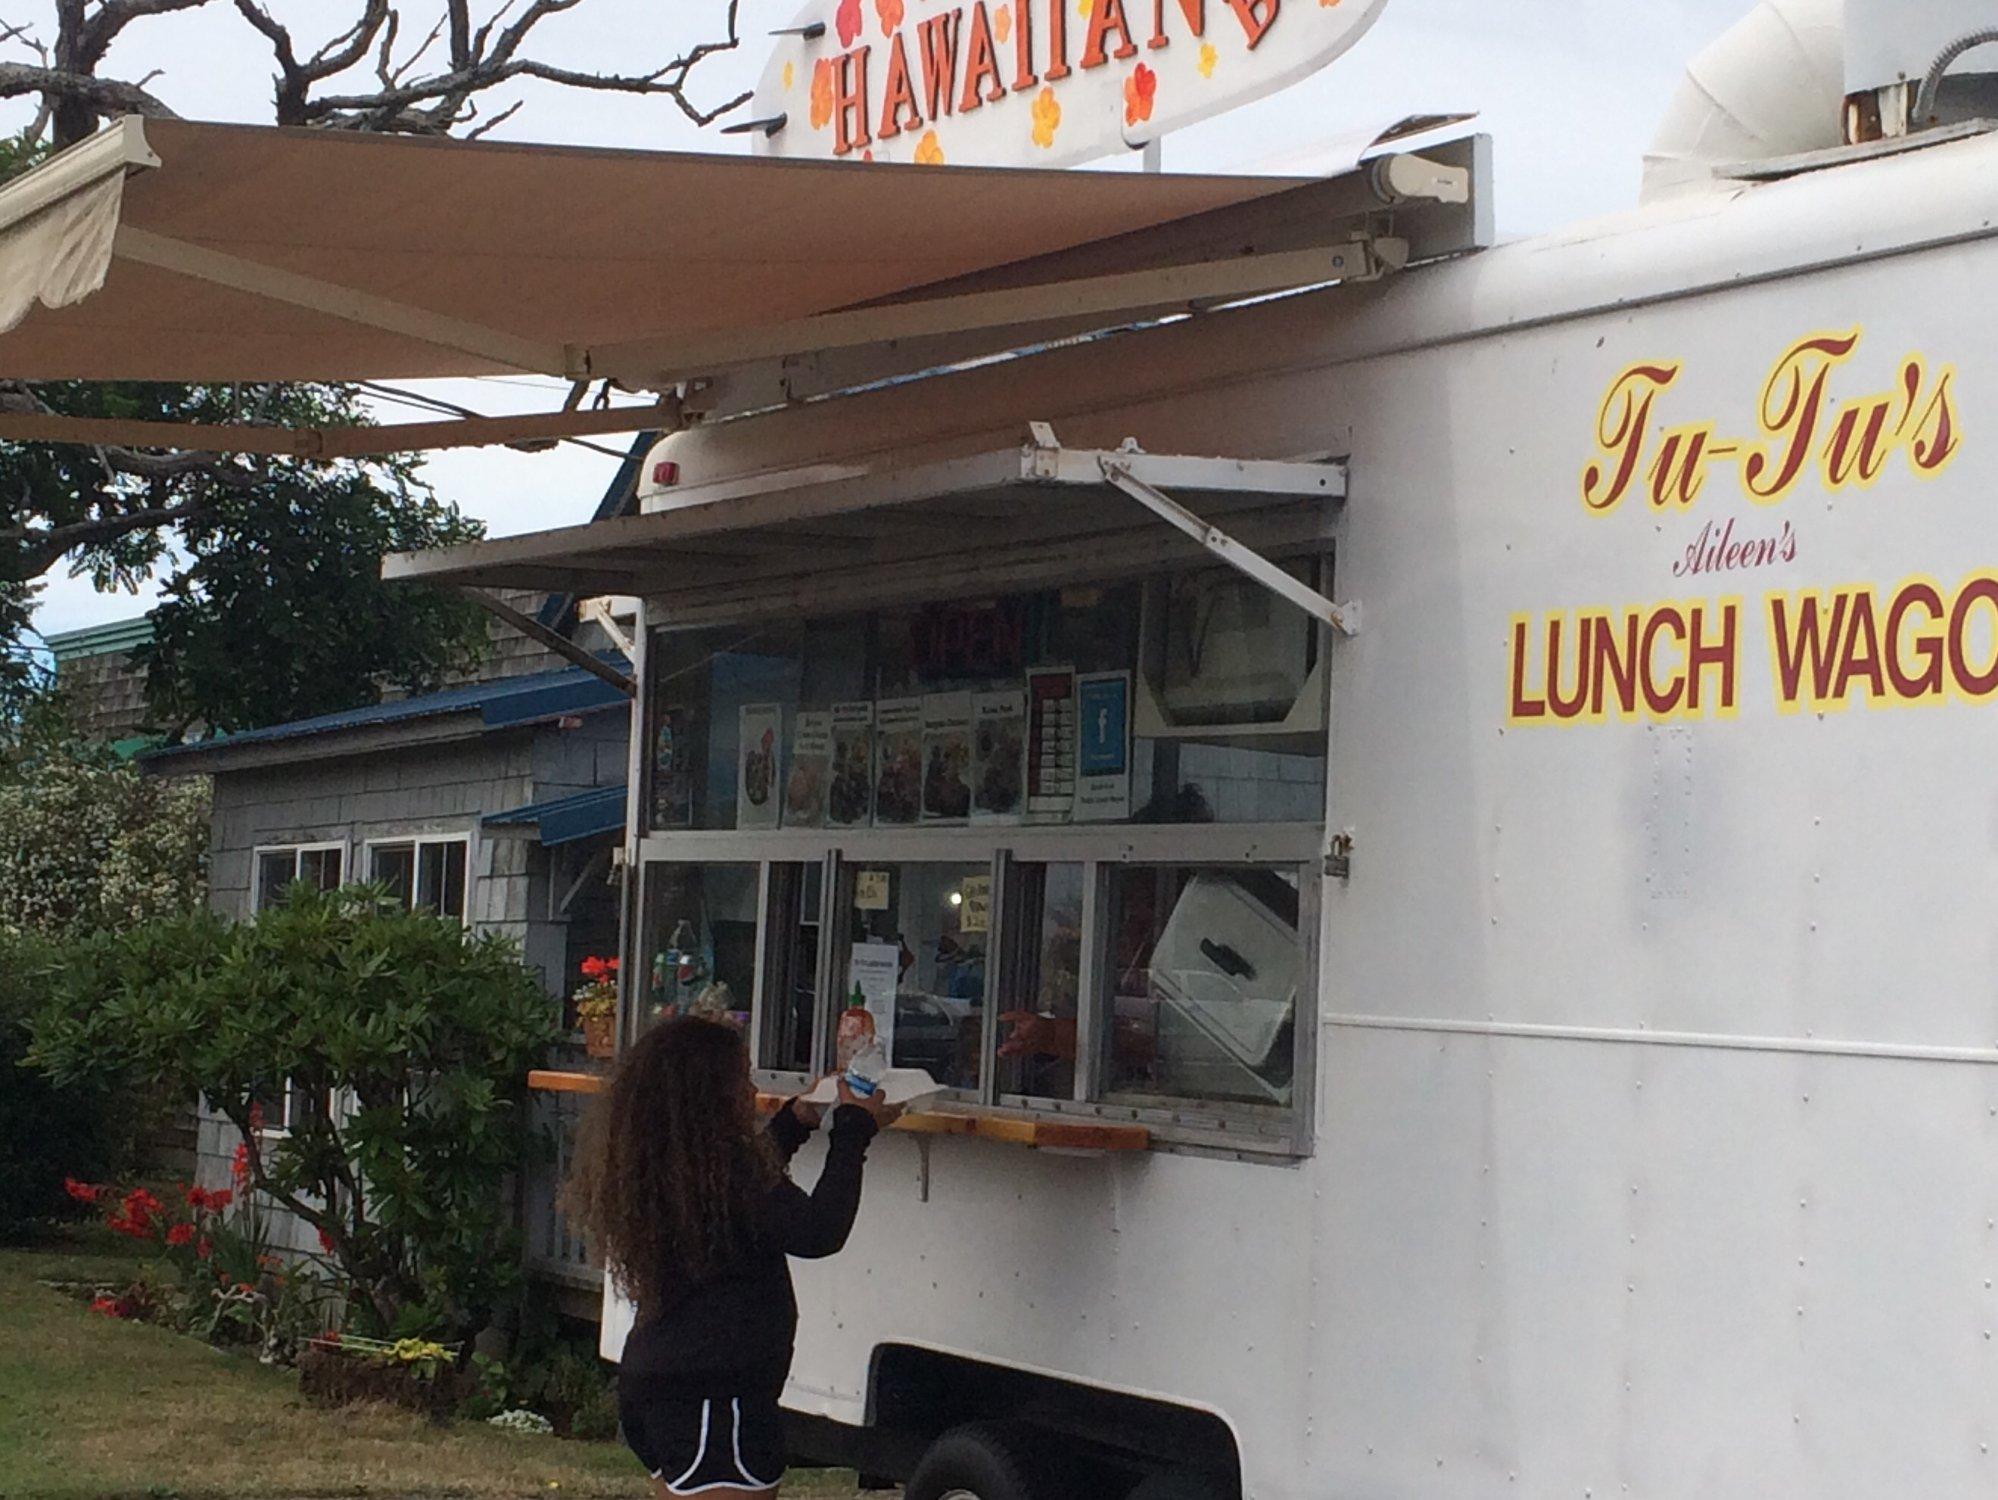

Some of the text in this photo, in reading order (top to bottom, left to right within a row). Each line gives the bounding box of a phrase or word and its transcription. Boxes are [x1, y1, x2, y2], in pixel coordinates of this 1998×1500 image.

[1583, 330, 1960, 511] Tu-Tu's
[1673, 518, 1798, 578] Aileen's
[1510, 577, 1998, 719] LUNCH WAGO
